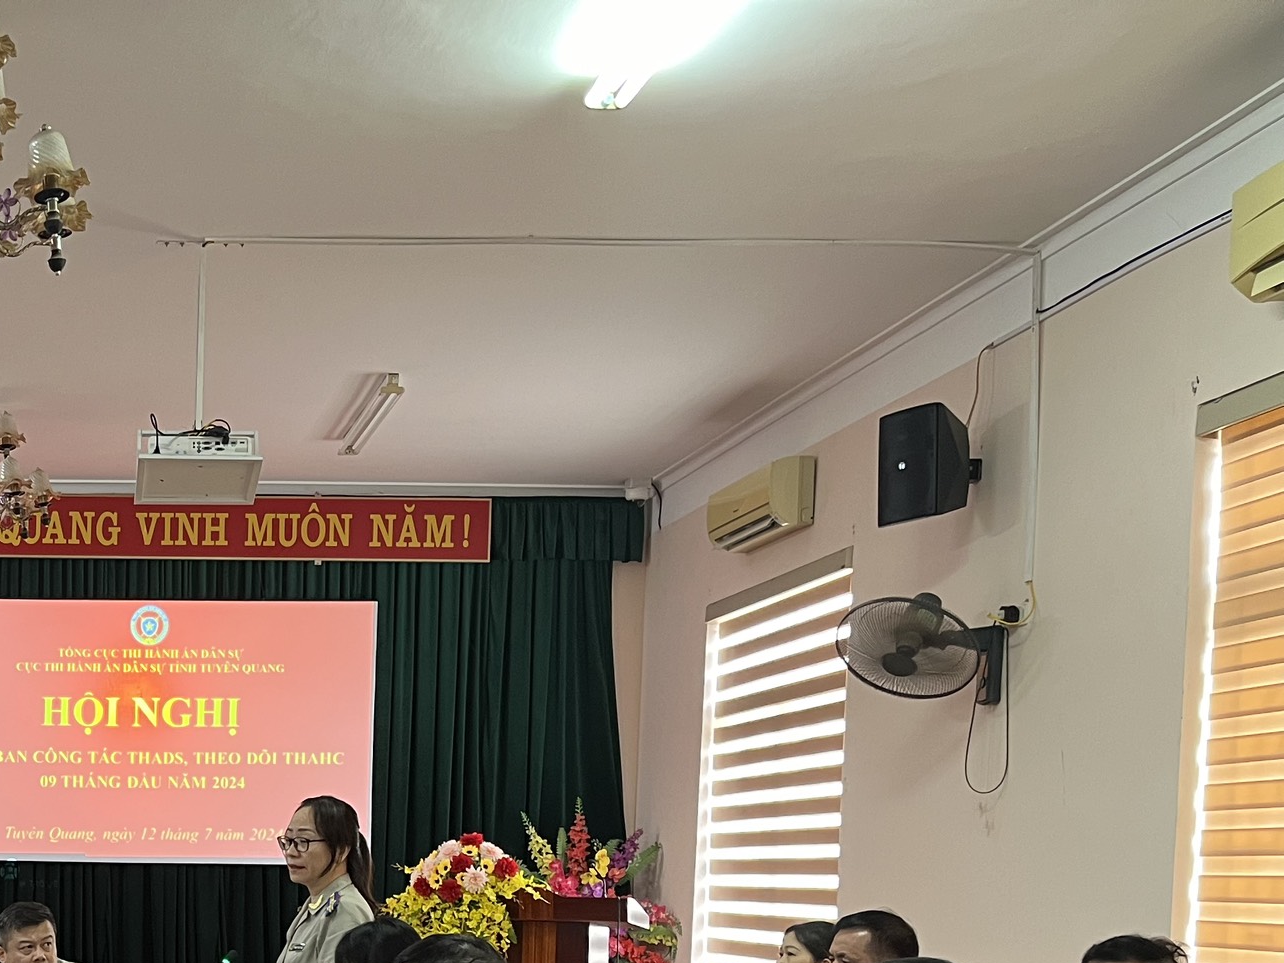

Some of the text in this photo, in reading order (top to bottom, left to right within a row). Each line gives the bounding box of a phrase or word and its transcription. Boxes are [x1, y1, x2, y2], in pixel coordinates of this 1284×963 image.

[135, 512, 229, 547] VINH
[244, 503, 353, 548] MUÔN
[368, 503, 455, 549] NĂM
[16, 661, 42, 674] CỤC
[44, 661, 64, 672] THI
[242, 663, 285, 675] QUANG
[41, 692, 241, 736] HỘI NGHỊ
[32, 747, 82, 765] CÔNG
[87, 748, 122, 765] TÁC
[127, 752, 188, 767] THADS,
[193, 752, 241, 765] THEO
[282, 752, 345, 766] THAHC
[40, 775, 57, 788] 09
[61, 772, 121, 789] THÁNG
[212, 777, 246, 789] 2024
[141, 827, 156, 840] 12
[204, 827, 213, 840] 7
